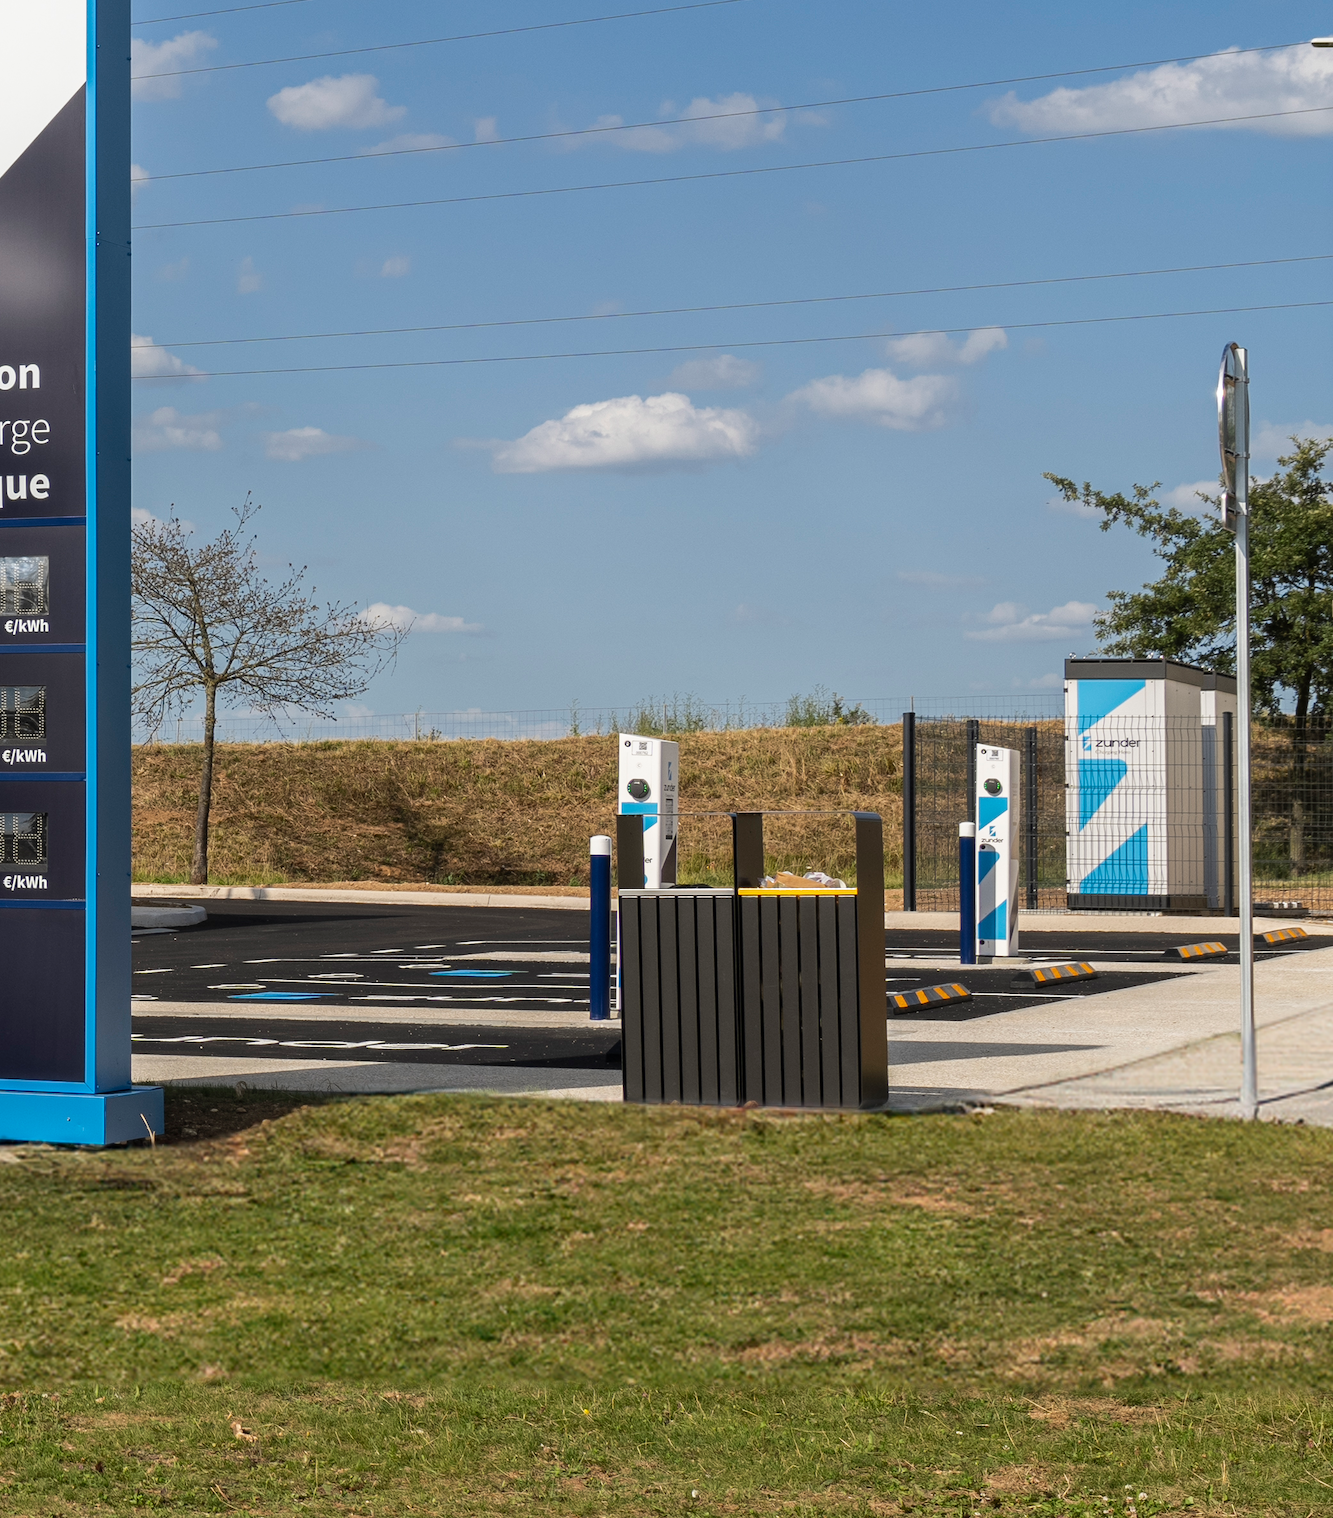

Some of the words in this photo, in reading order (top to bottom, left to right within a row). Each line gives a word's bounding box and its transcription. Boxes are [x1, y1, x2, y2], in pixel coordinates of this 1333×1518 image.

[4, 618, 50, 635] €/kWh
[1095, 737, 1141, 748] zunder
[1, 749, 47, 765] €/kWh
[3, 875, 48, 891] €/kWh
